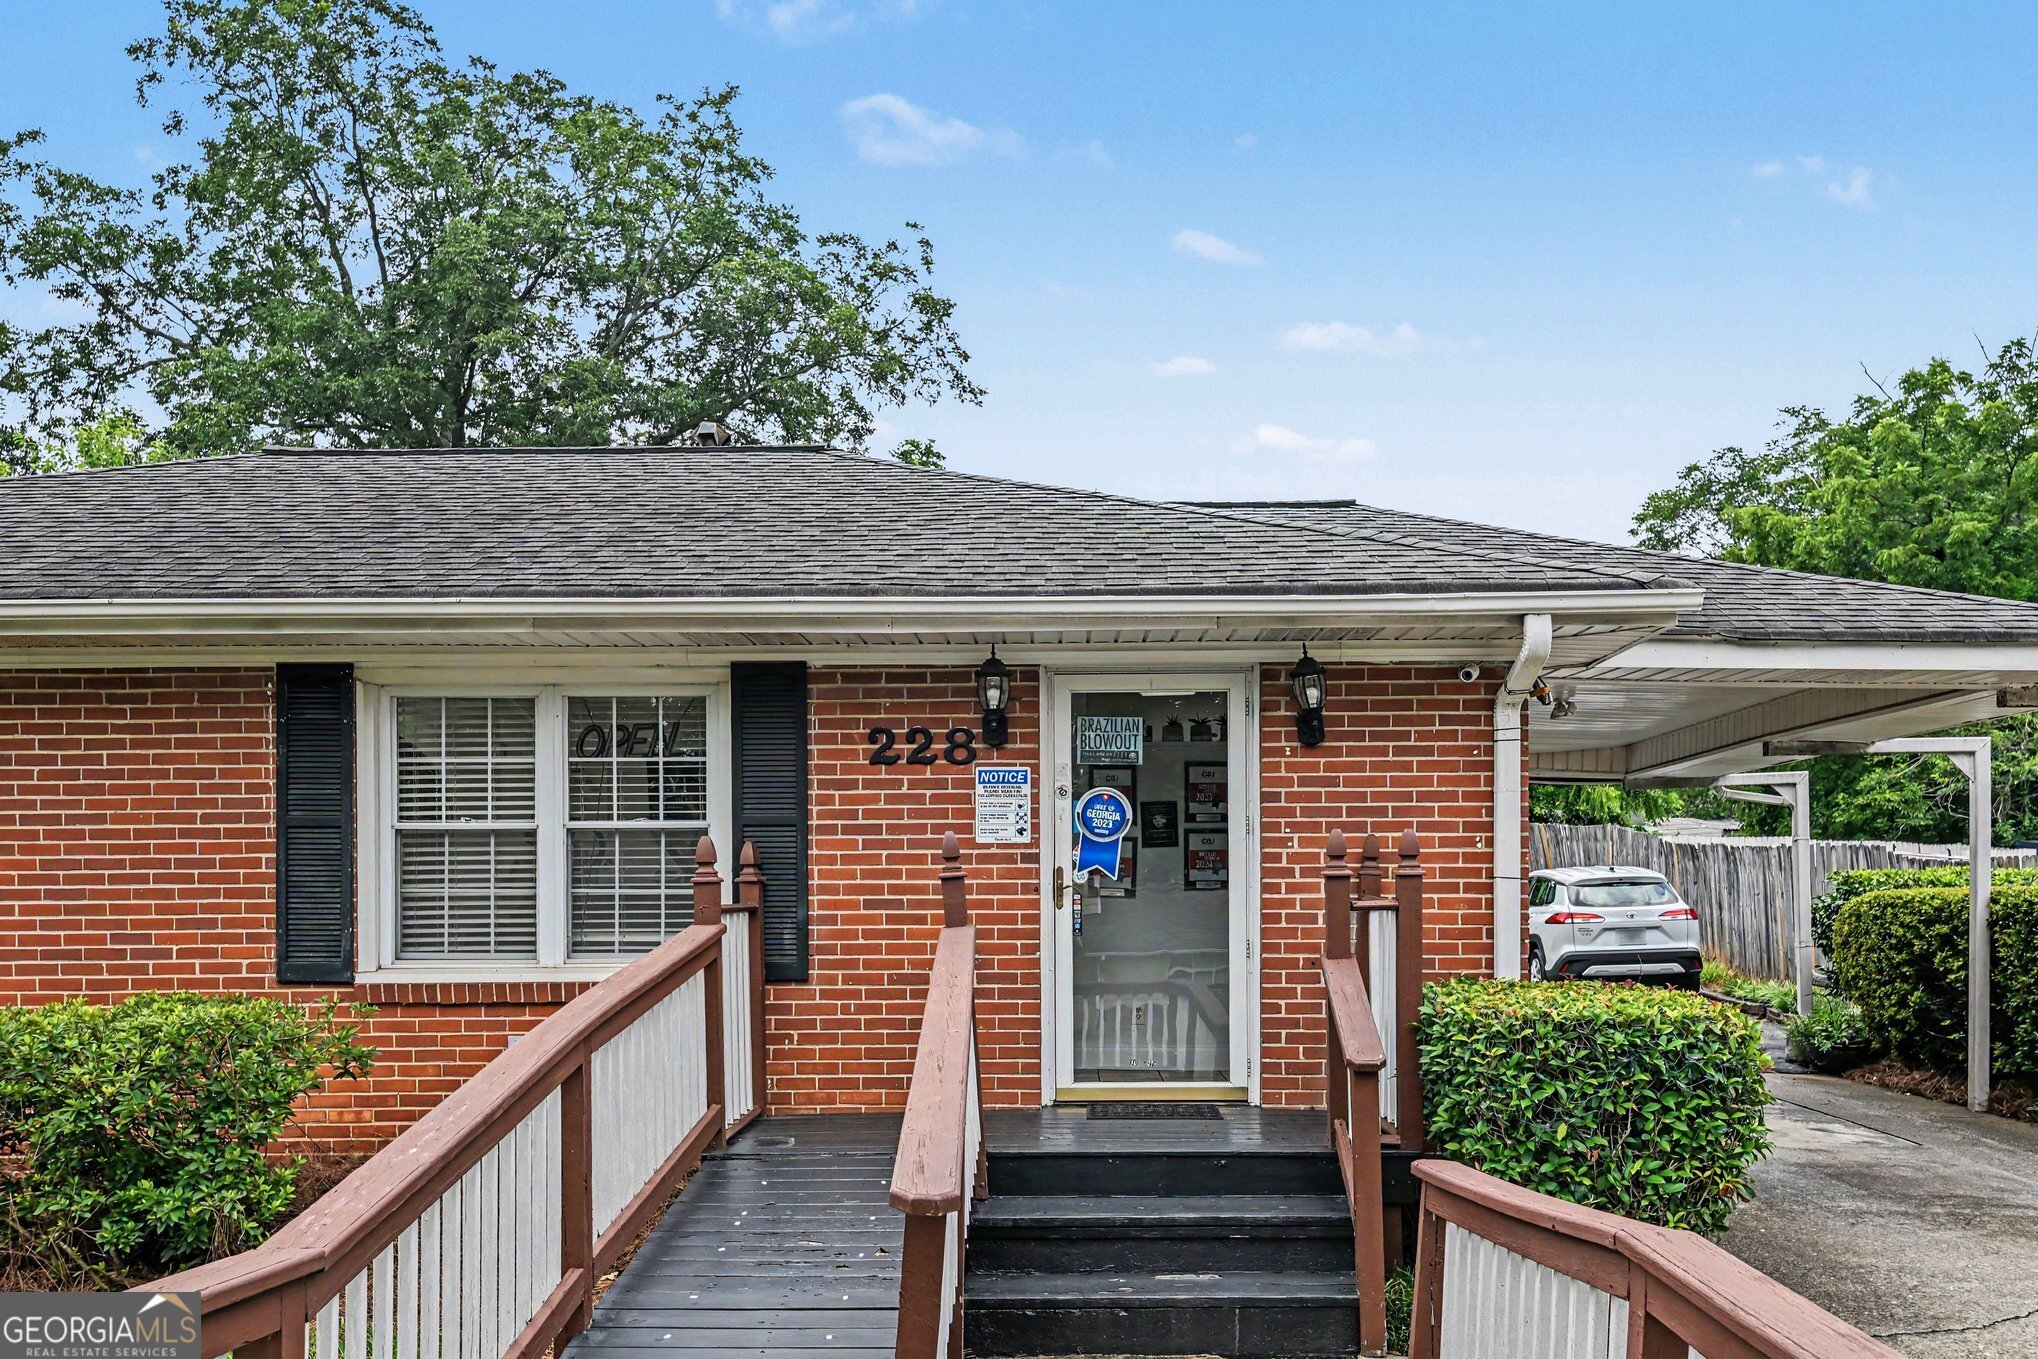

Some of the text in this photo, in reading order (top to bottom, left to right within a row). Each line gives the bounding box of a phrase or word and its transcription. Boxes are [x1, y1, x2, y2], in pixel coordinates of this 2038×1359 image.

[1080, 717, 1140, 733] BRAZILIAN
[576, 721, 680, 760] OPEN
[868, 727, 977, 765] 228
[1080, 733, 1139, 750] BLOWOUT
[980, 771, 1026, 783] NOTICE
[1086, 808, 1121, 821] GEORGIA
[1092, 818, 1113, 829] 2023
